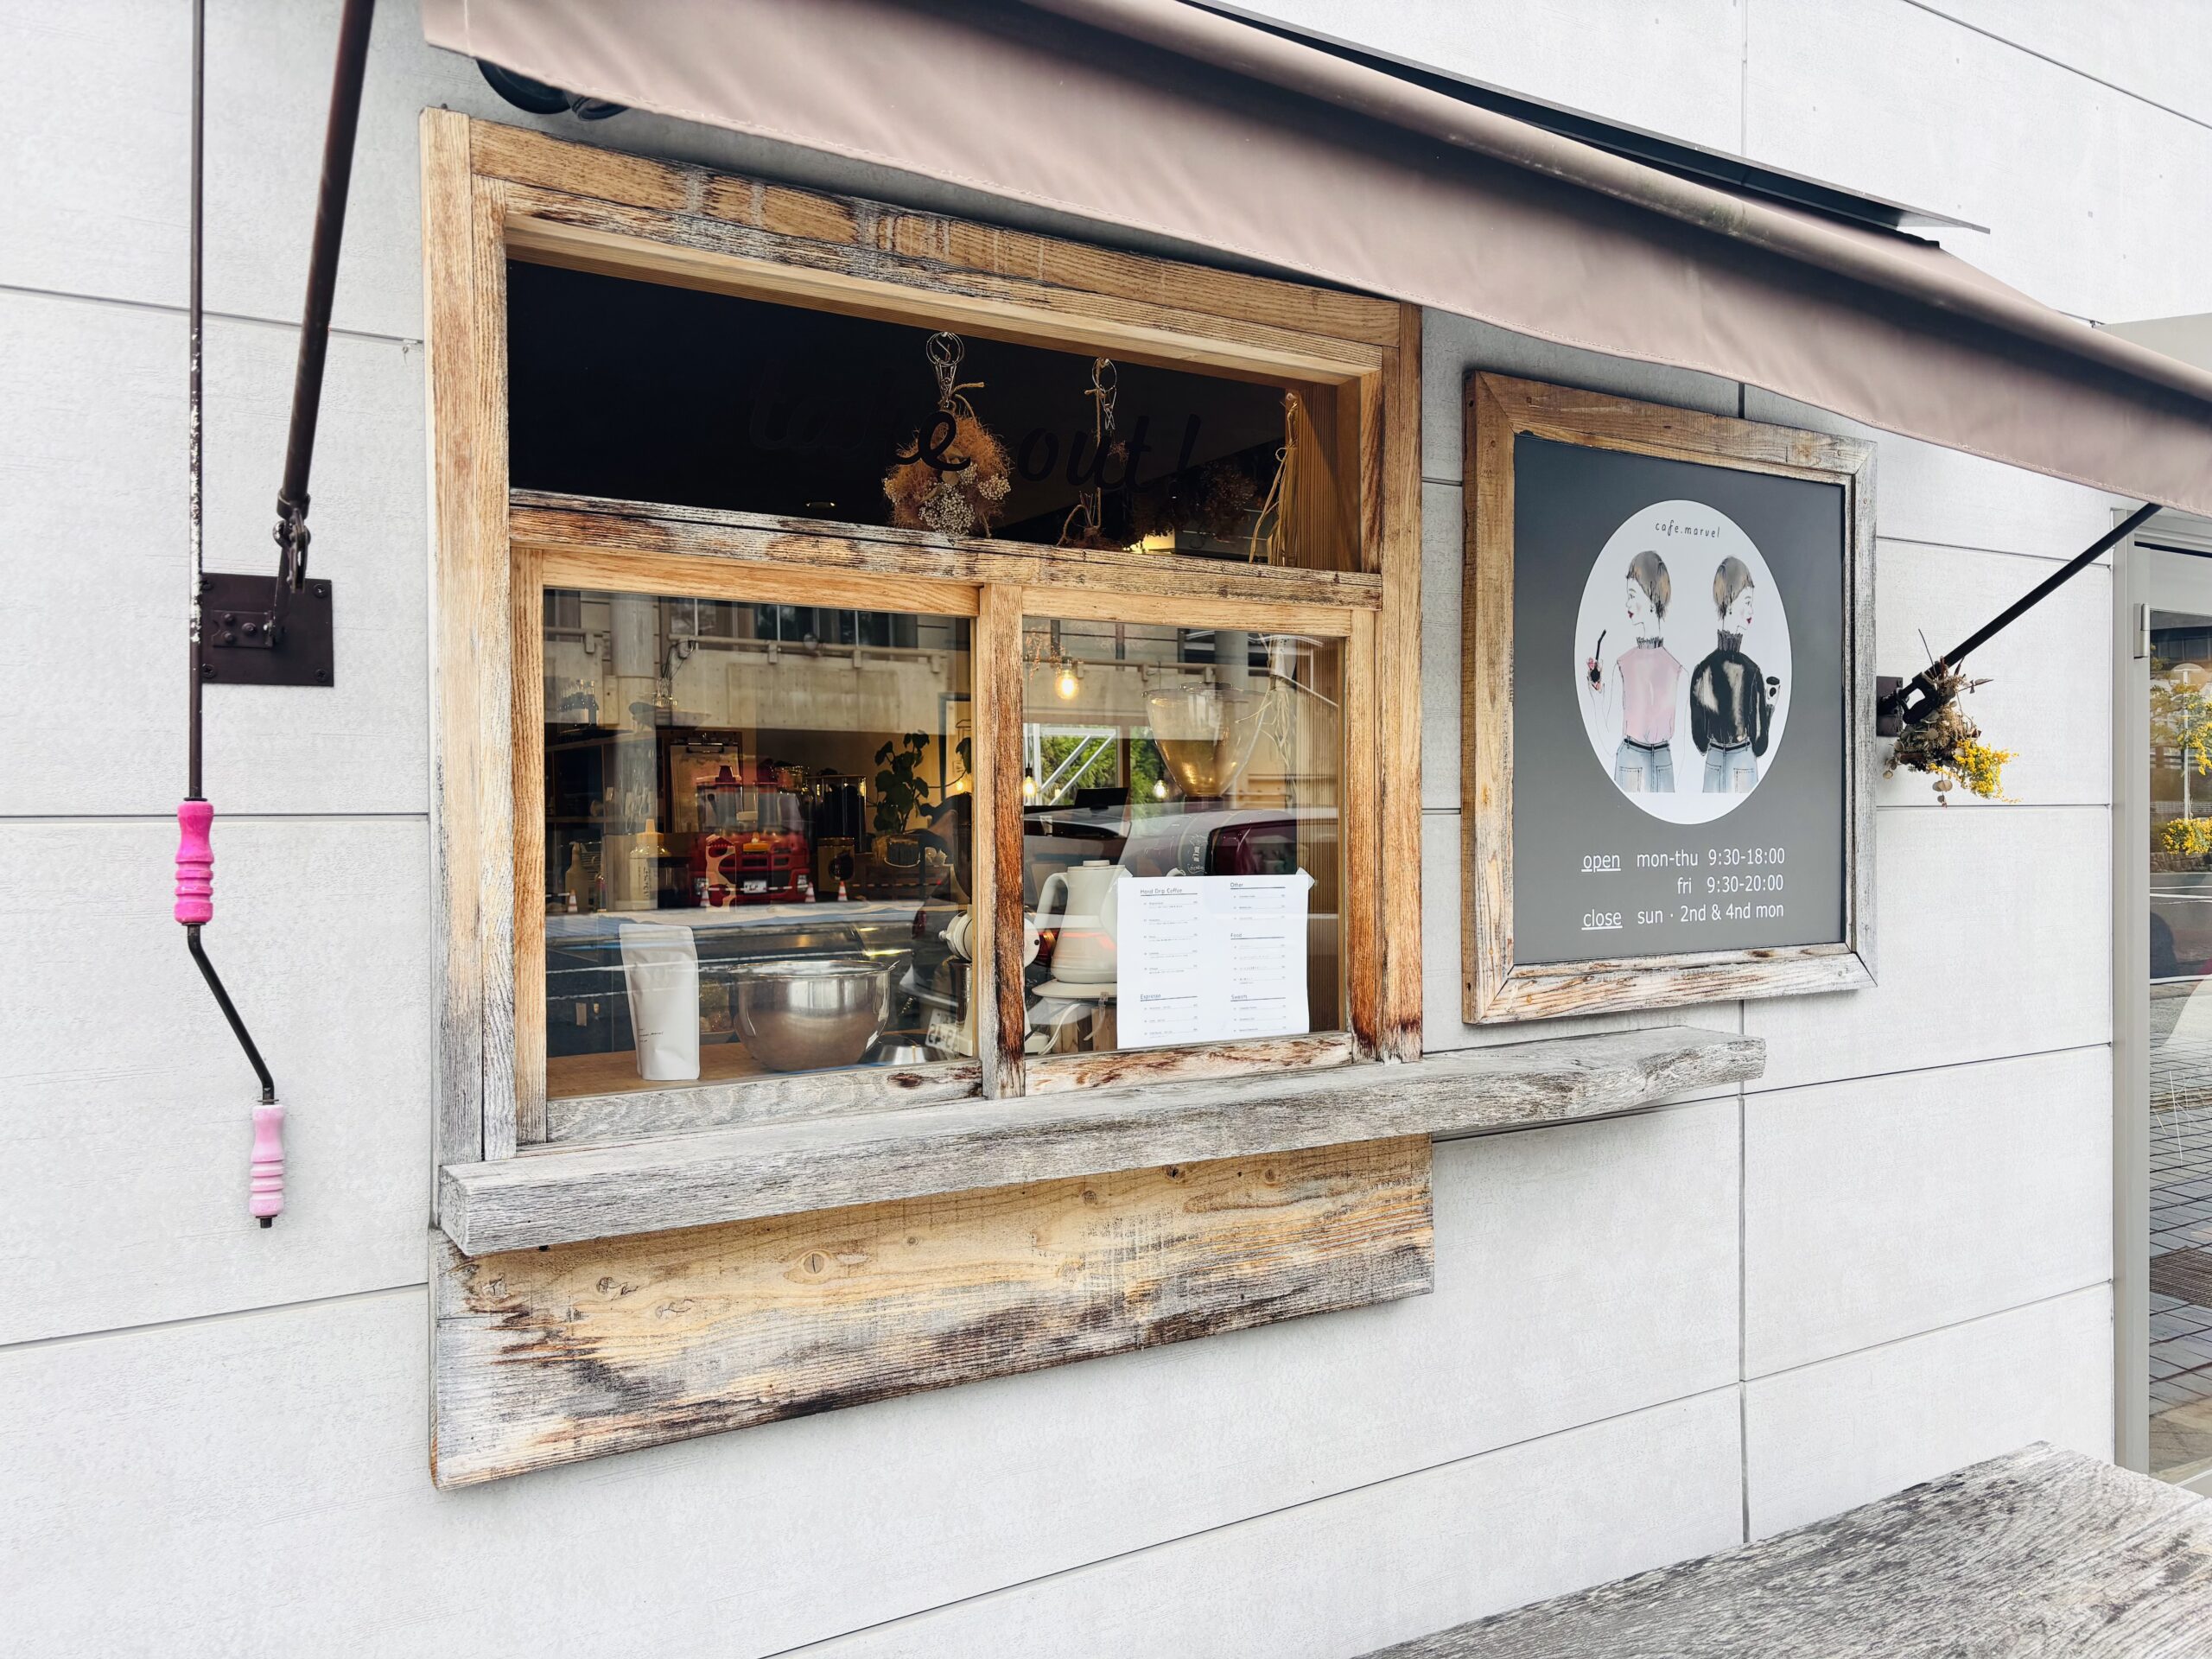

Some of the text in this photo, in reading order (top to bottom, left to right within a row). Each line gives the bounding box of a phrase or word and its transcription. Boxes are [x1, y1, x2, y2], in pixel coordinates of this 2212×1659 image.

[1655, 519, 1720, 538] cafe.marvel
[1582, 848, 1785, 873] open mon-thu 9:30-18:00
[1677, 874, 1784, 894] fri 9:30-20:00
[1583, 908, 1623, 928] close
[1637, 910, 1663, 925] sun
[1680, 904, 1707, 923] 2nd
[1711, 903, 1722, 921] &
[1726, 901, 1751, 920] 4nd
[1756, 904, 1784, 918] mon
